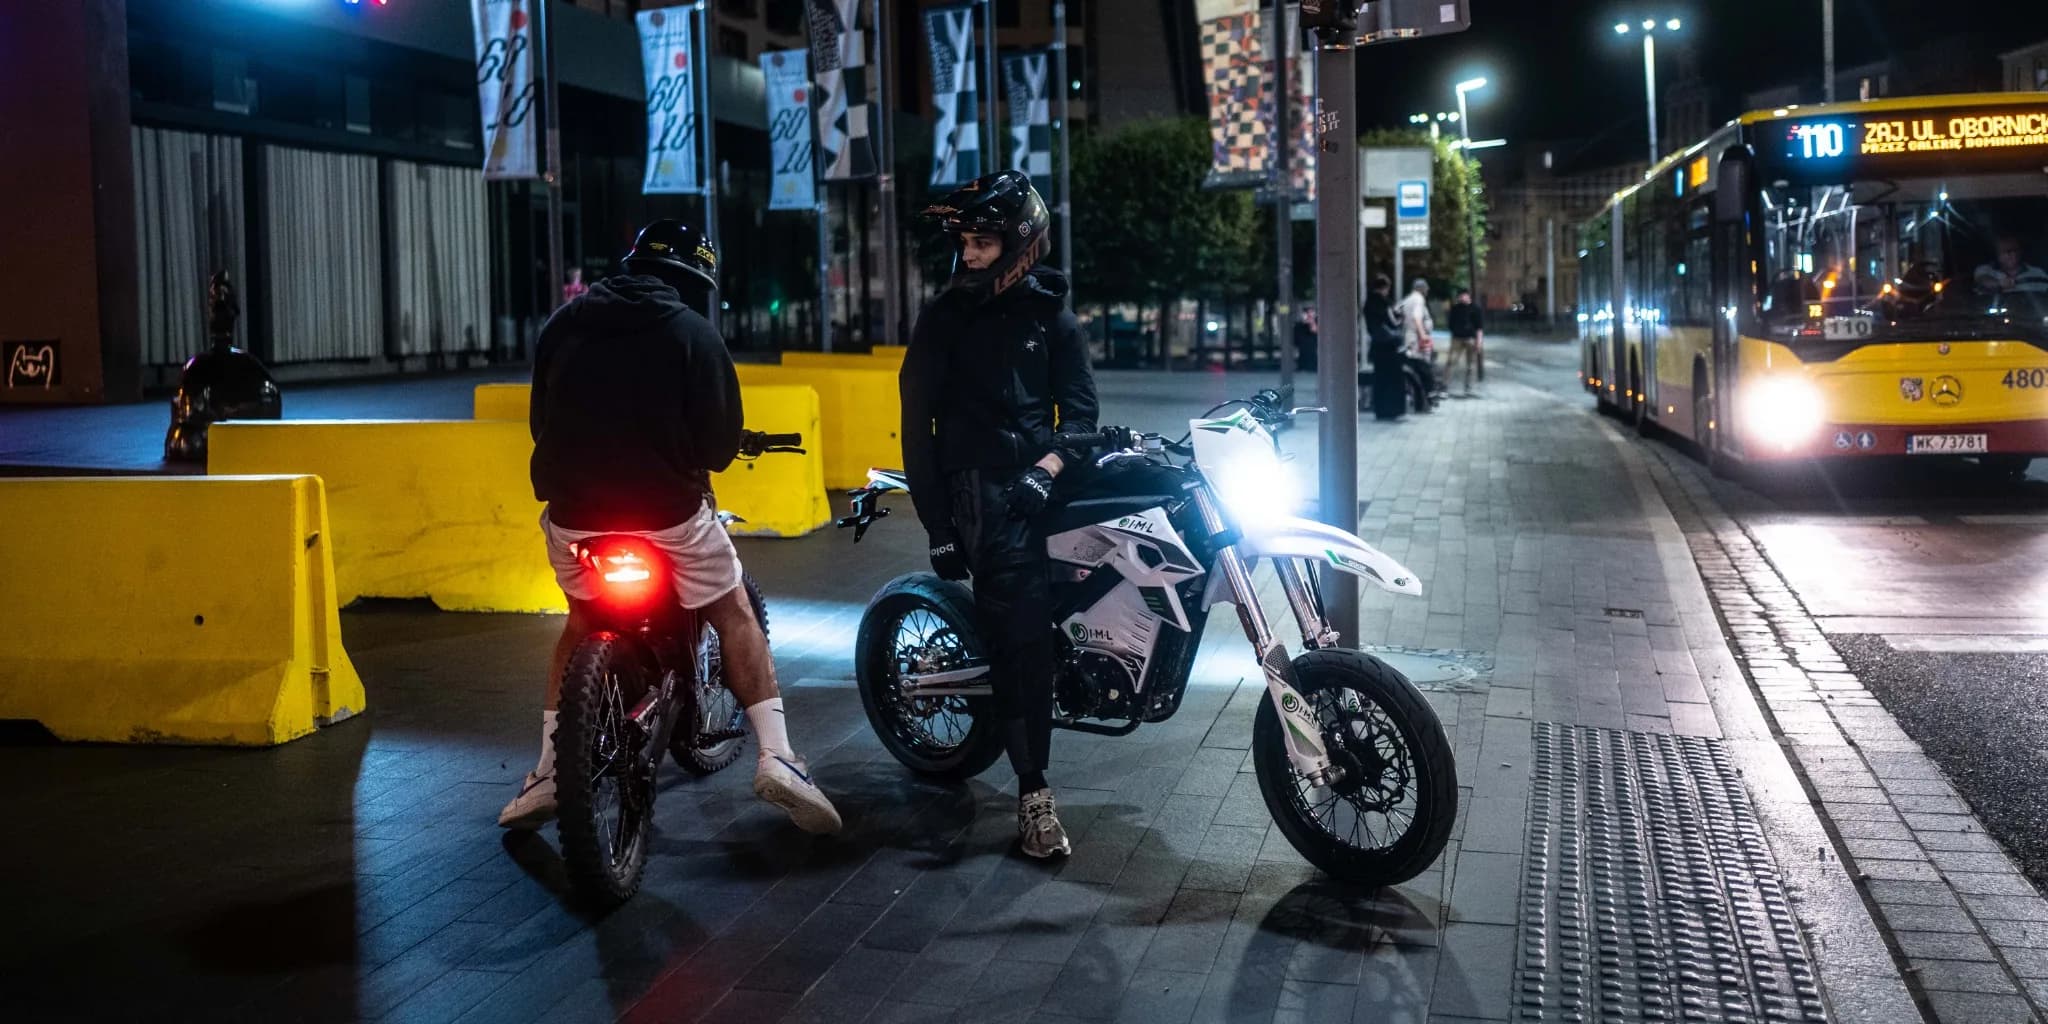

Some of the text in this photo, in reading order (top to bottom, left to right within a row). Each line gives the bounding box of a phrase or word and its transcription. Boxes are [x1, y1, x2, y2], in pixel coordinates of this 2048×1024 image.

[648, 73, 688, 115] 60
[770, 107, 807, 143] 60
[1864, 121, 1909, 143] ZAJ.
[1912, 119, 1946, 141] UL.
[1798, 123, 1843, 158] 110
[1830, 320, 1868, 337] 110
[2001, 368, 2048, 390] 480
[1916, 434, 1983, 449] WK 73781
